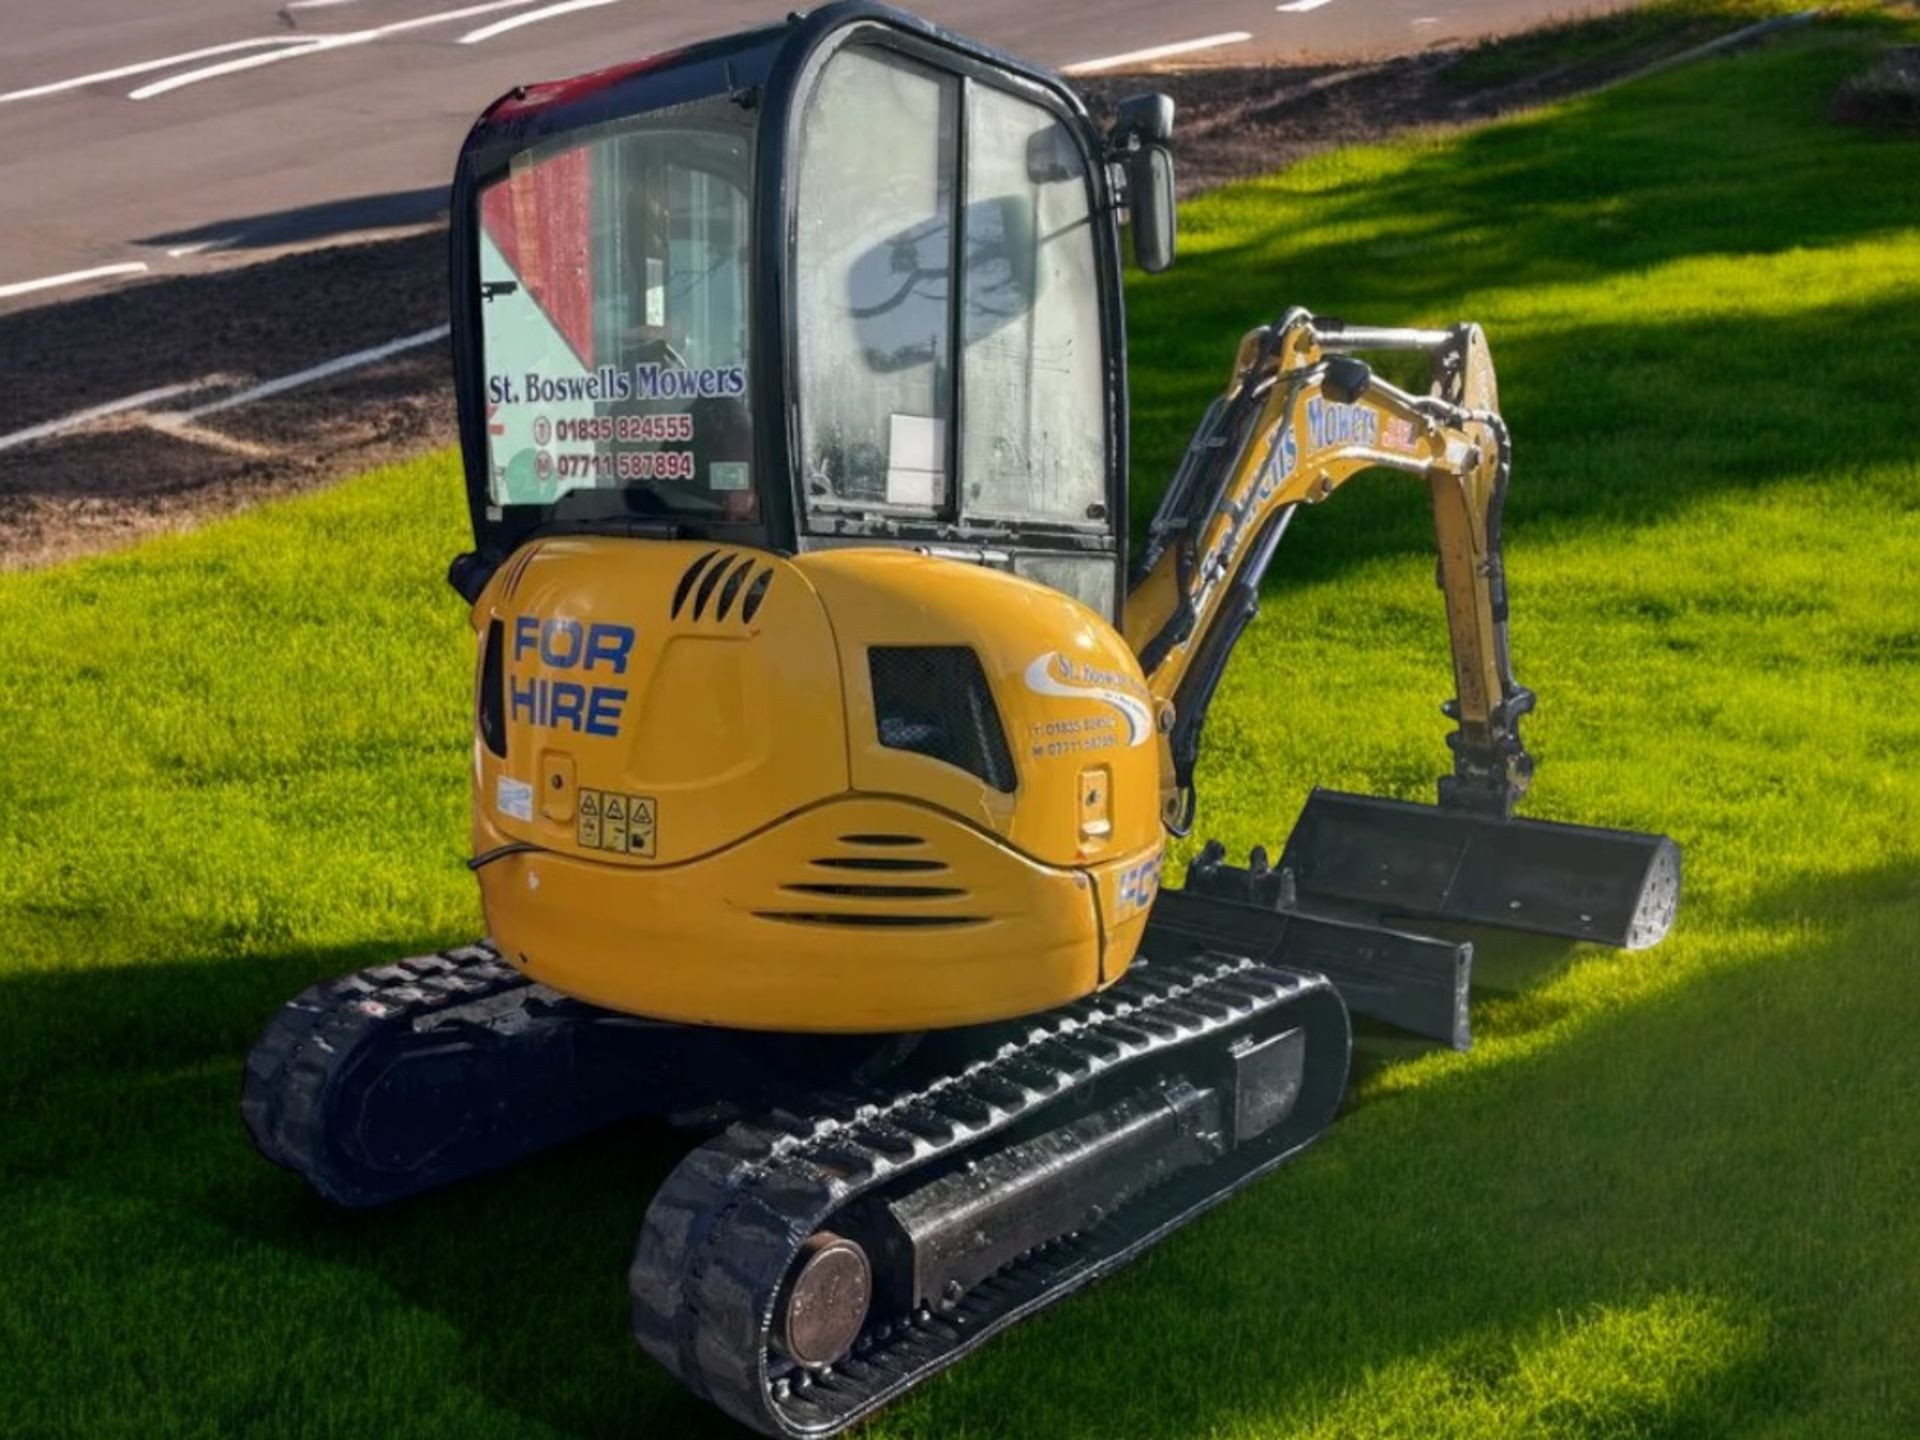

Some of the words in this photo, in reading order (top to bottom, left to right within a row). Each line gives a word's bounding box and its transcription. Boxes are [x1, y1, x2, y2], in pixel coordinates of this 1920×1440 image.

[489, 375, 519, 404] St.
[525, 366, 630, 402] Boswells
[636, 362, 747, 399] Mowers
[556, 416, 612, 442] 01835
[616, 414, 693, 441] 824555
[1307, 395, 1378, 449] Mowers
[558, 454, 612, 478] 07711
[617, 452, 694, 479] 587894
[515, 617, 635, 674] FOR
[510, 675, 628, 737] HIRE
